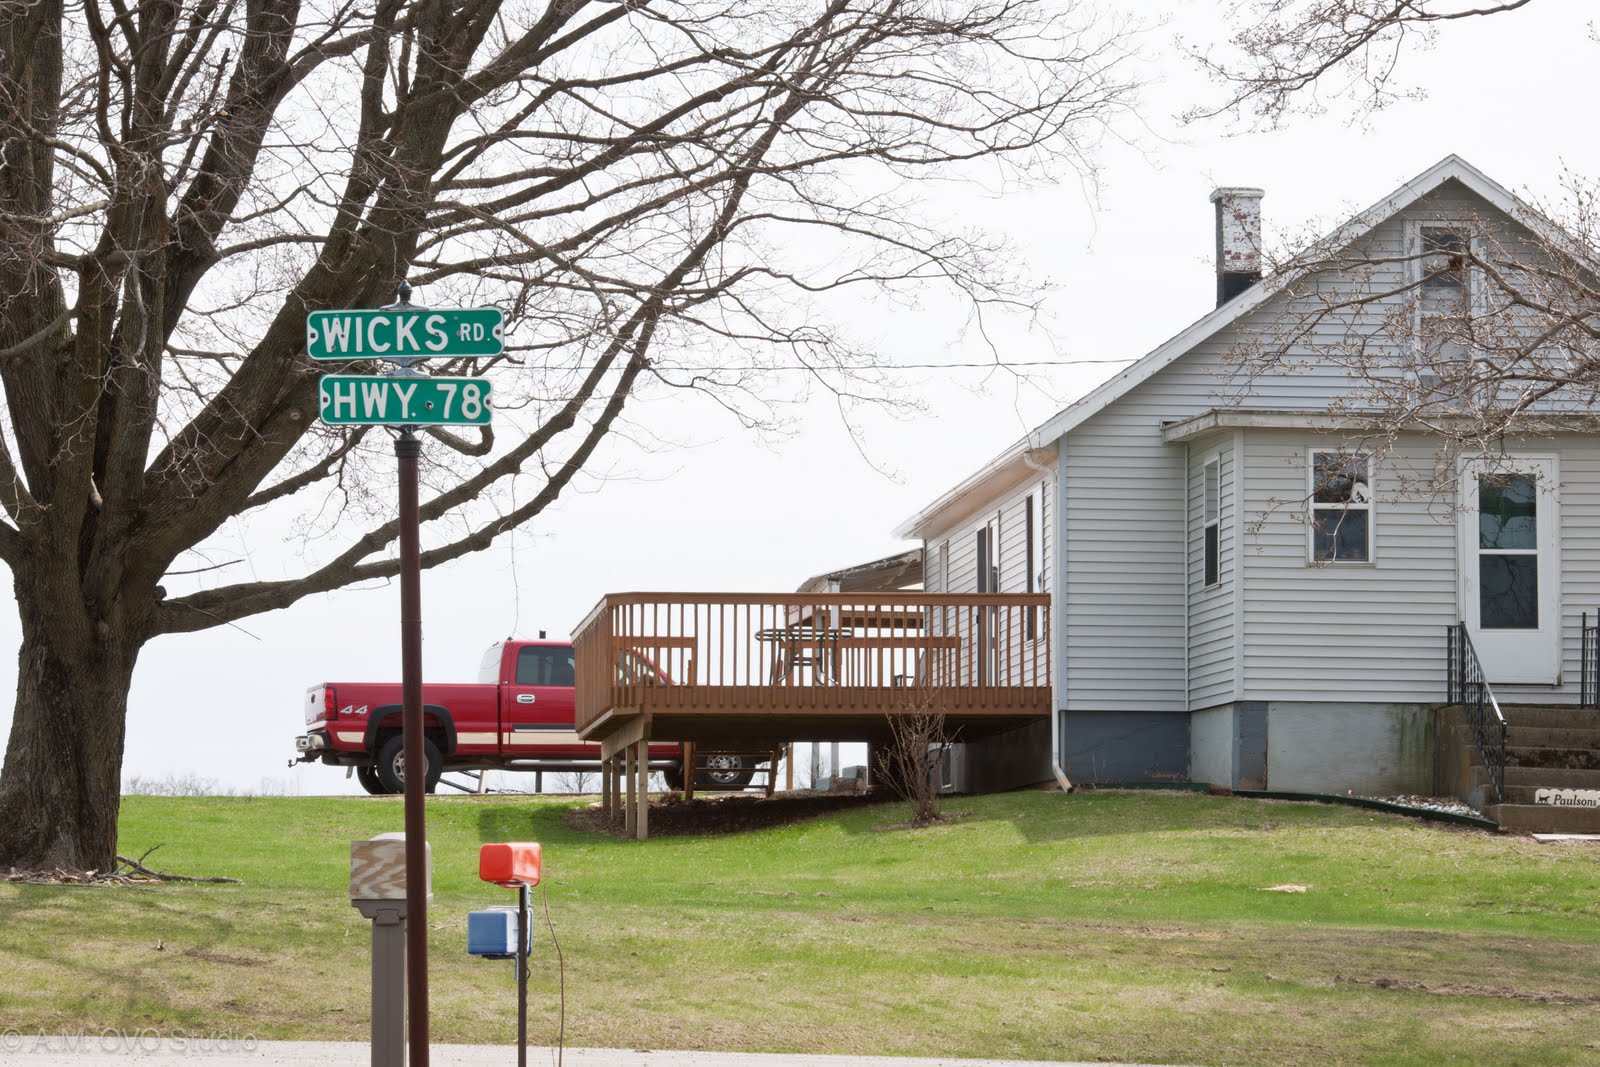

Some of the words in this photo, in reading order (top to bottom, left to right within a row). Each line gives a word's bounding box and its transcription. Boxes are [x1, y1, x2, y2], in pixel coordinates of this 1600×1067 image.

[321, 314, 449, 353] WICKS
[459, 322, 491, 342] RD.
[333, 381, 418, 419] HWY.
[436, 383, 482, 420] 78
[1553, 794, 1597, 807] Paulsons
